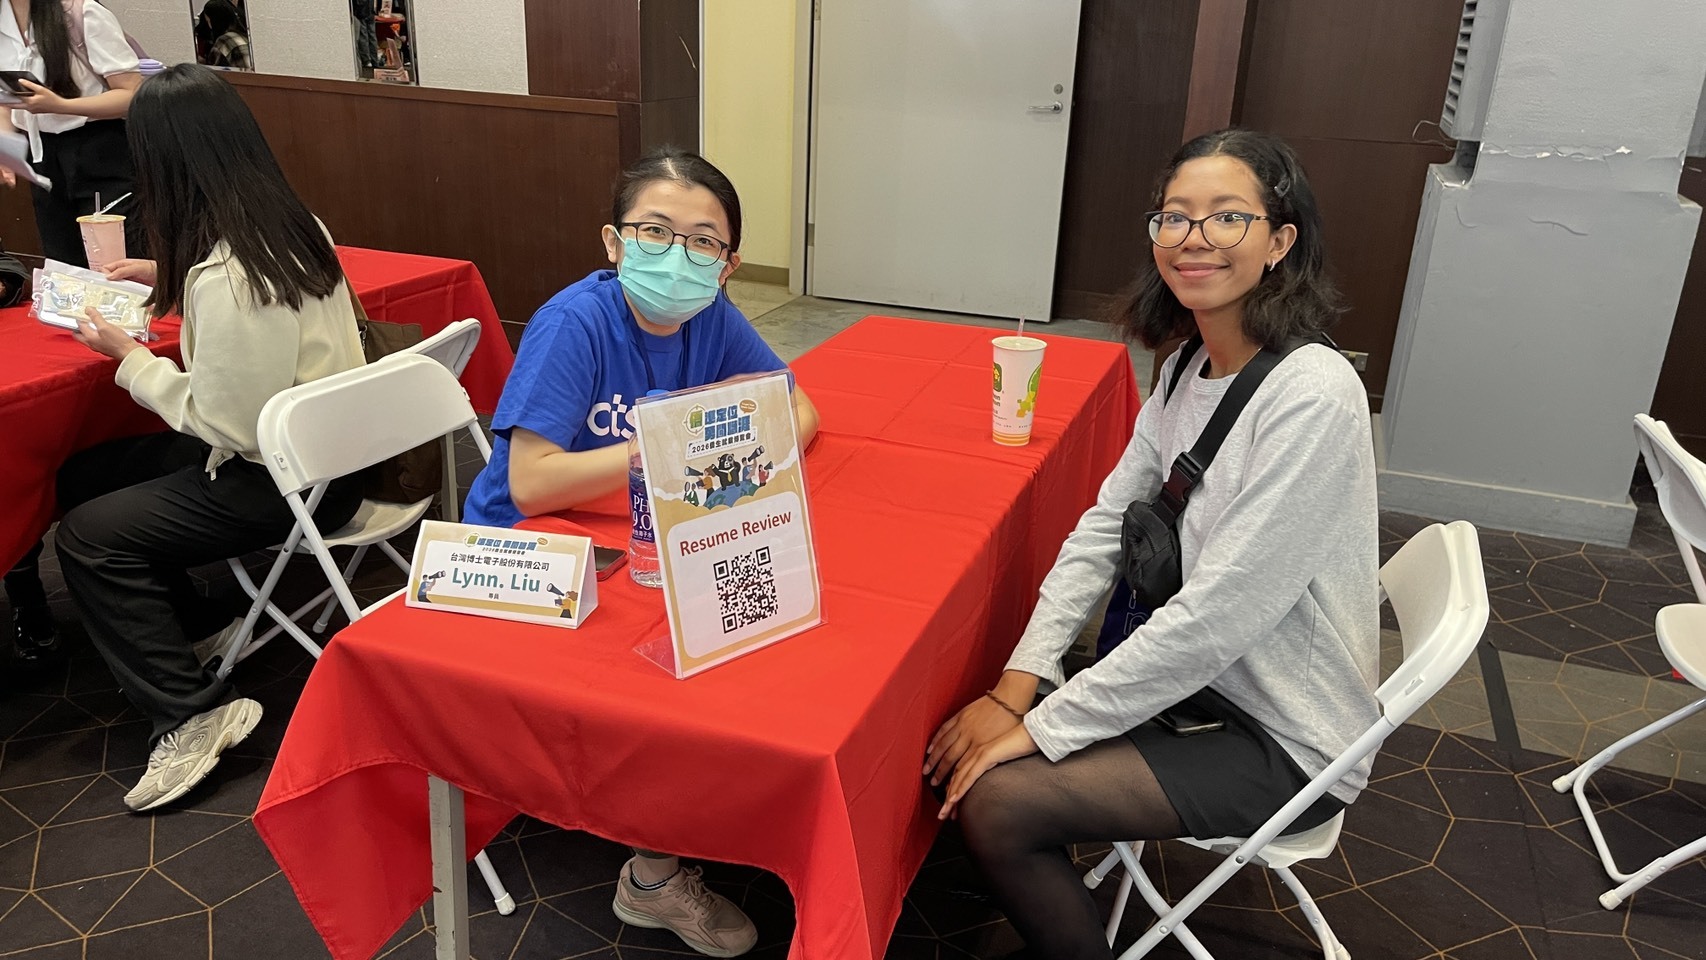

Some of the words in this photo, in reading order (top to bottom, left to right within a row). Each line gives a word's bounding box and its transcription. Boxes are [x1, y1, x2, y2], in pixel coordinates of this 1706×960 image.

[633, 494, 650, 513] PH
[633, 510, 652, 531] 9.0
[680, 528, 738, 557] Resume
[742, 511, 791, 537] Review
[450, 552, 550, 572] 台灣博士電子股份有限公司
[452, 567, 504, 589] Lynn.
[511, 573, 541, 593] Liu
